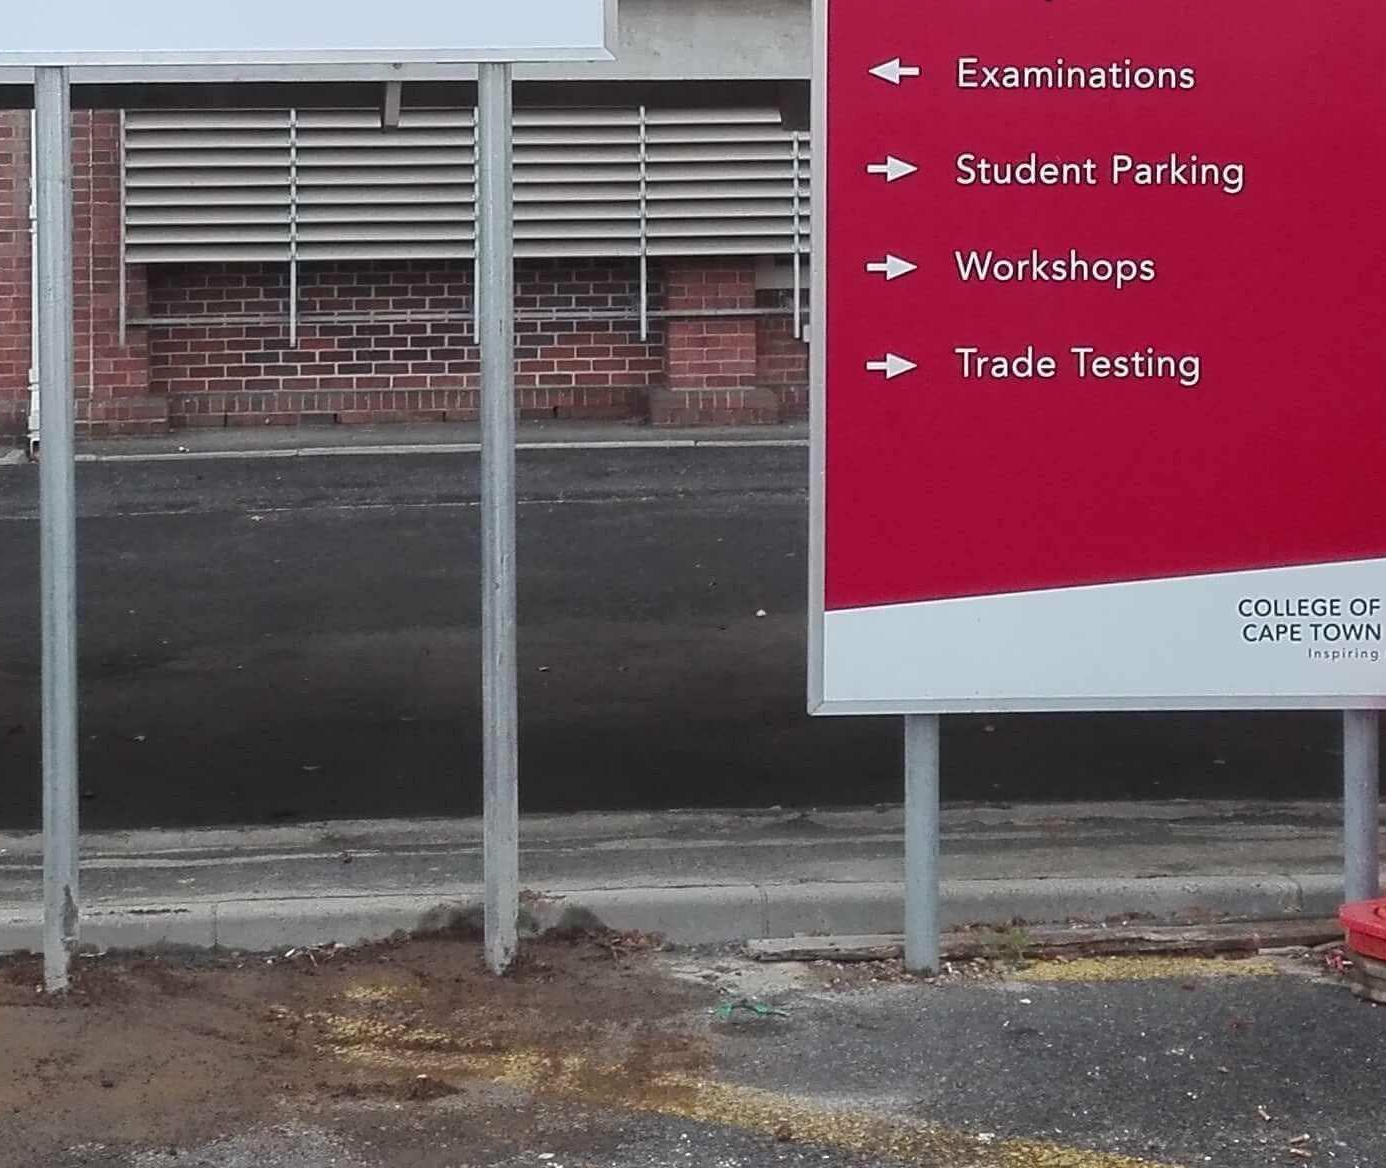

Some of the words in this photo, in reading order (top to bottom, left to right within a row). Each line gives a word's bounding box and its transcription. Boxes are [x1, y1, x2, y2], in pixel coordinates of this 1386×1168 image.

[958, 57, 1195, 89] Examinations
[956, 152, 1097, 185] Student
[1113, 153, 1243, 194] Parking
[955, 249, 1155, 289] Workshops
[955, 346, 1056, 378] Trade
[1070, 347, 1200, 386] Testing
[1238, 598, 1342, 618] COLLEGE
[1349, 598, 1381, 617] OF
[1242, 623, 1302, 642] CAPE
[1309, 623, 1381, 642] TOWN
[1308, 647, 1379, 662] Inspiring
